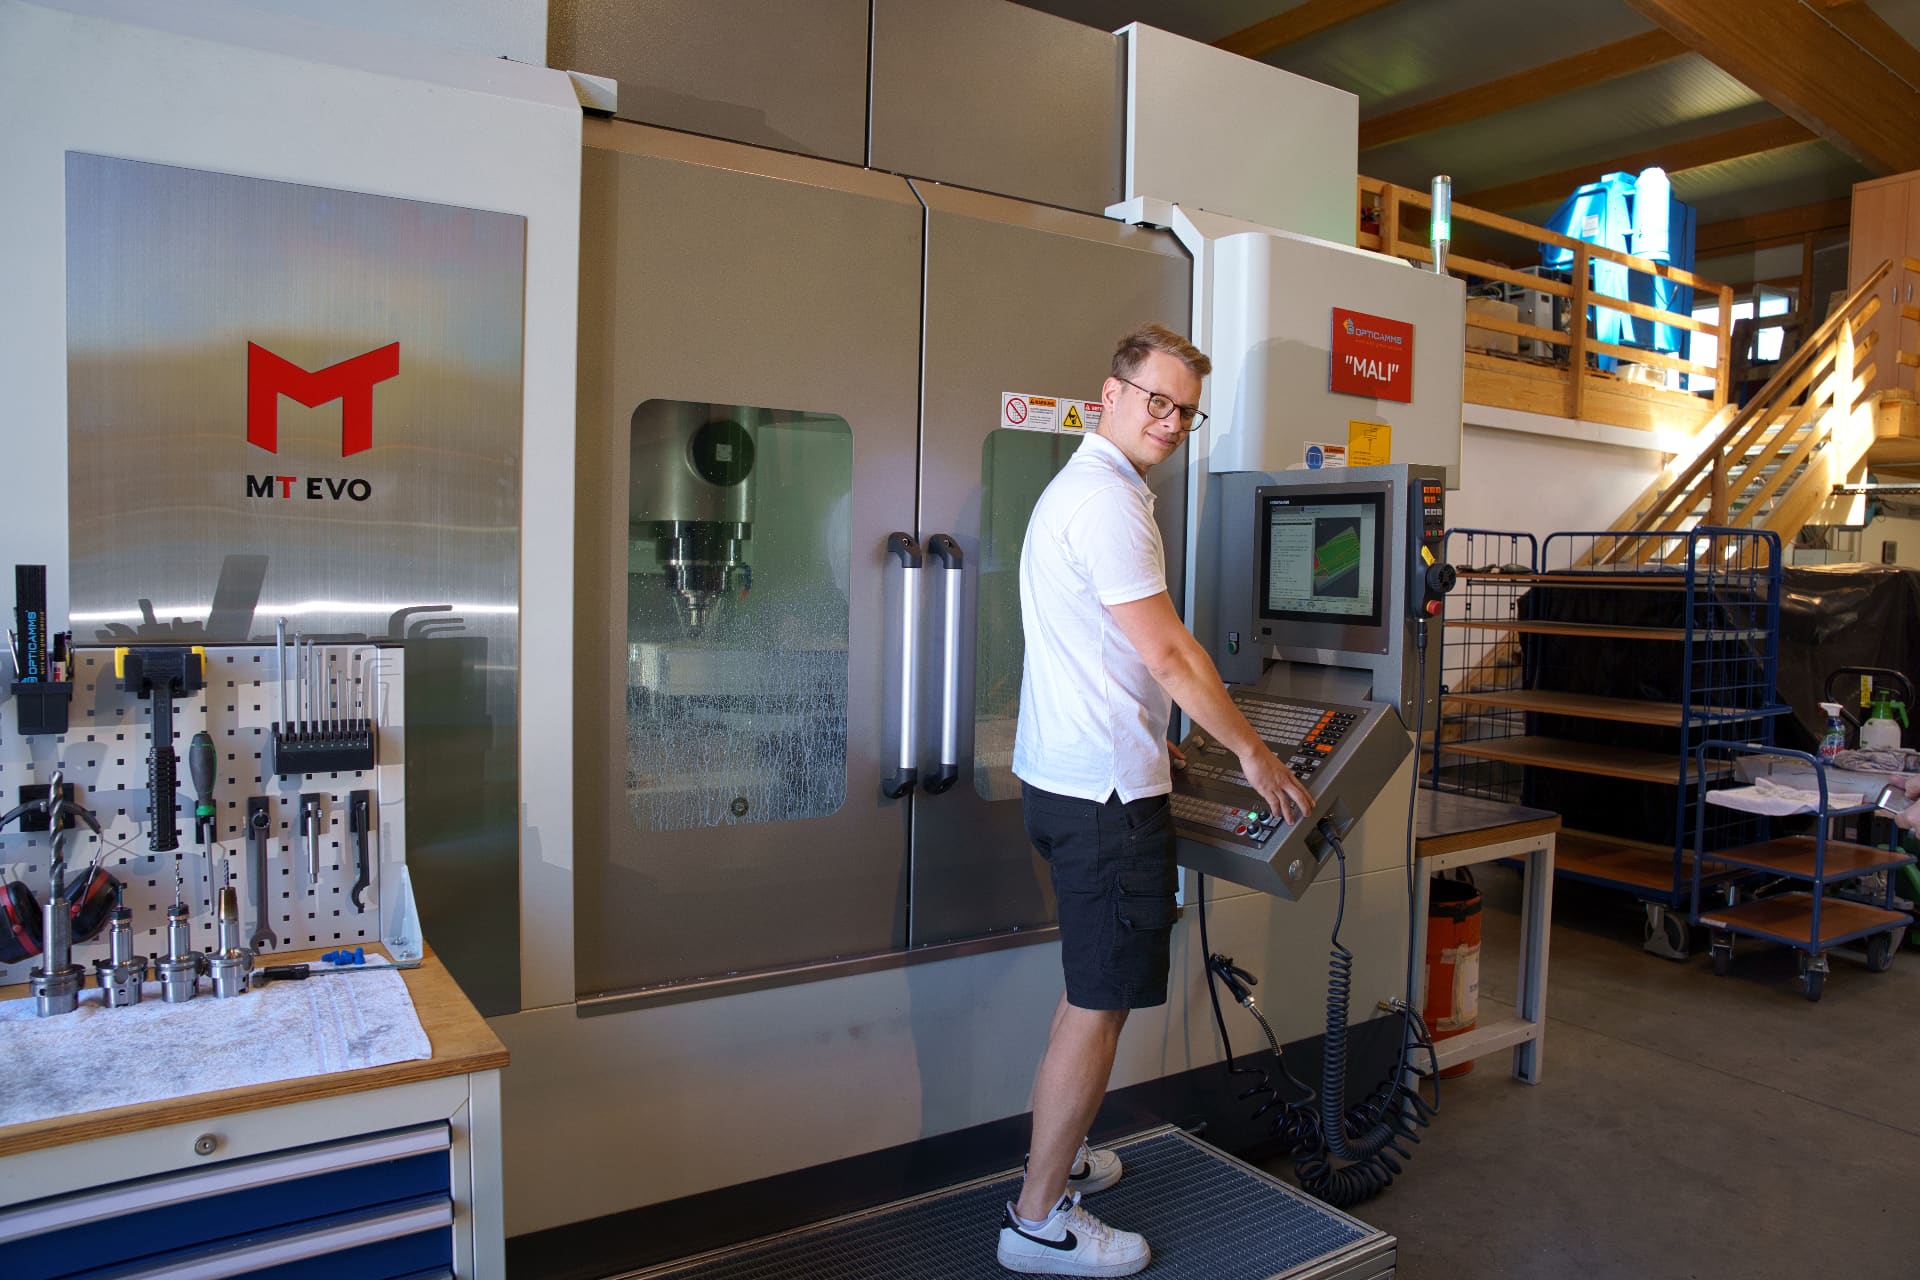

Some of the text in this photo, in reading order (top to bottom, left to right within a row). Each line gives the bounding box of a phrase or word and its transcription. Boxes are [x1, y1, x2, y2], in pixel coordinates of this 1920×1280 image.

[1355, 328, 1403, 345] OPTICAMMS
[1345, 354, 1400, 382] "MALI"
[246, 474, 372, 502] MT EVO
[27, 610, 38, 675] OPTICAMMS
